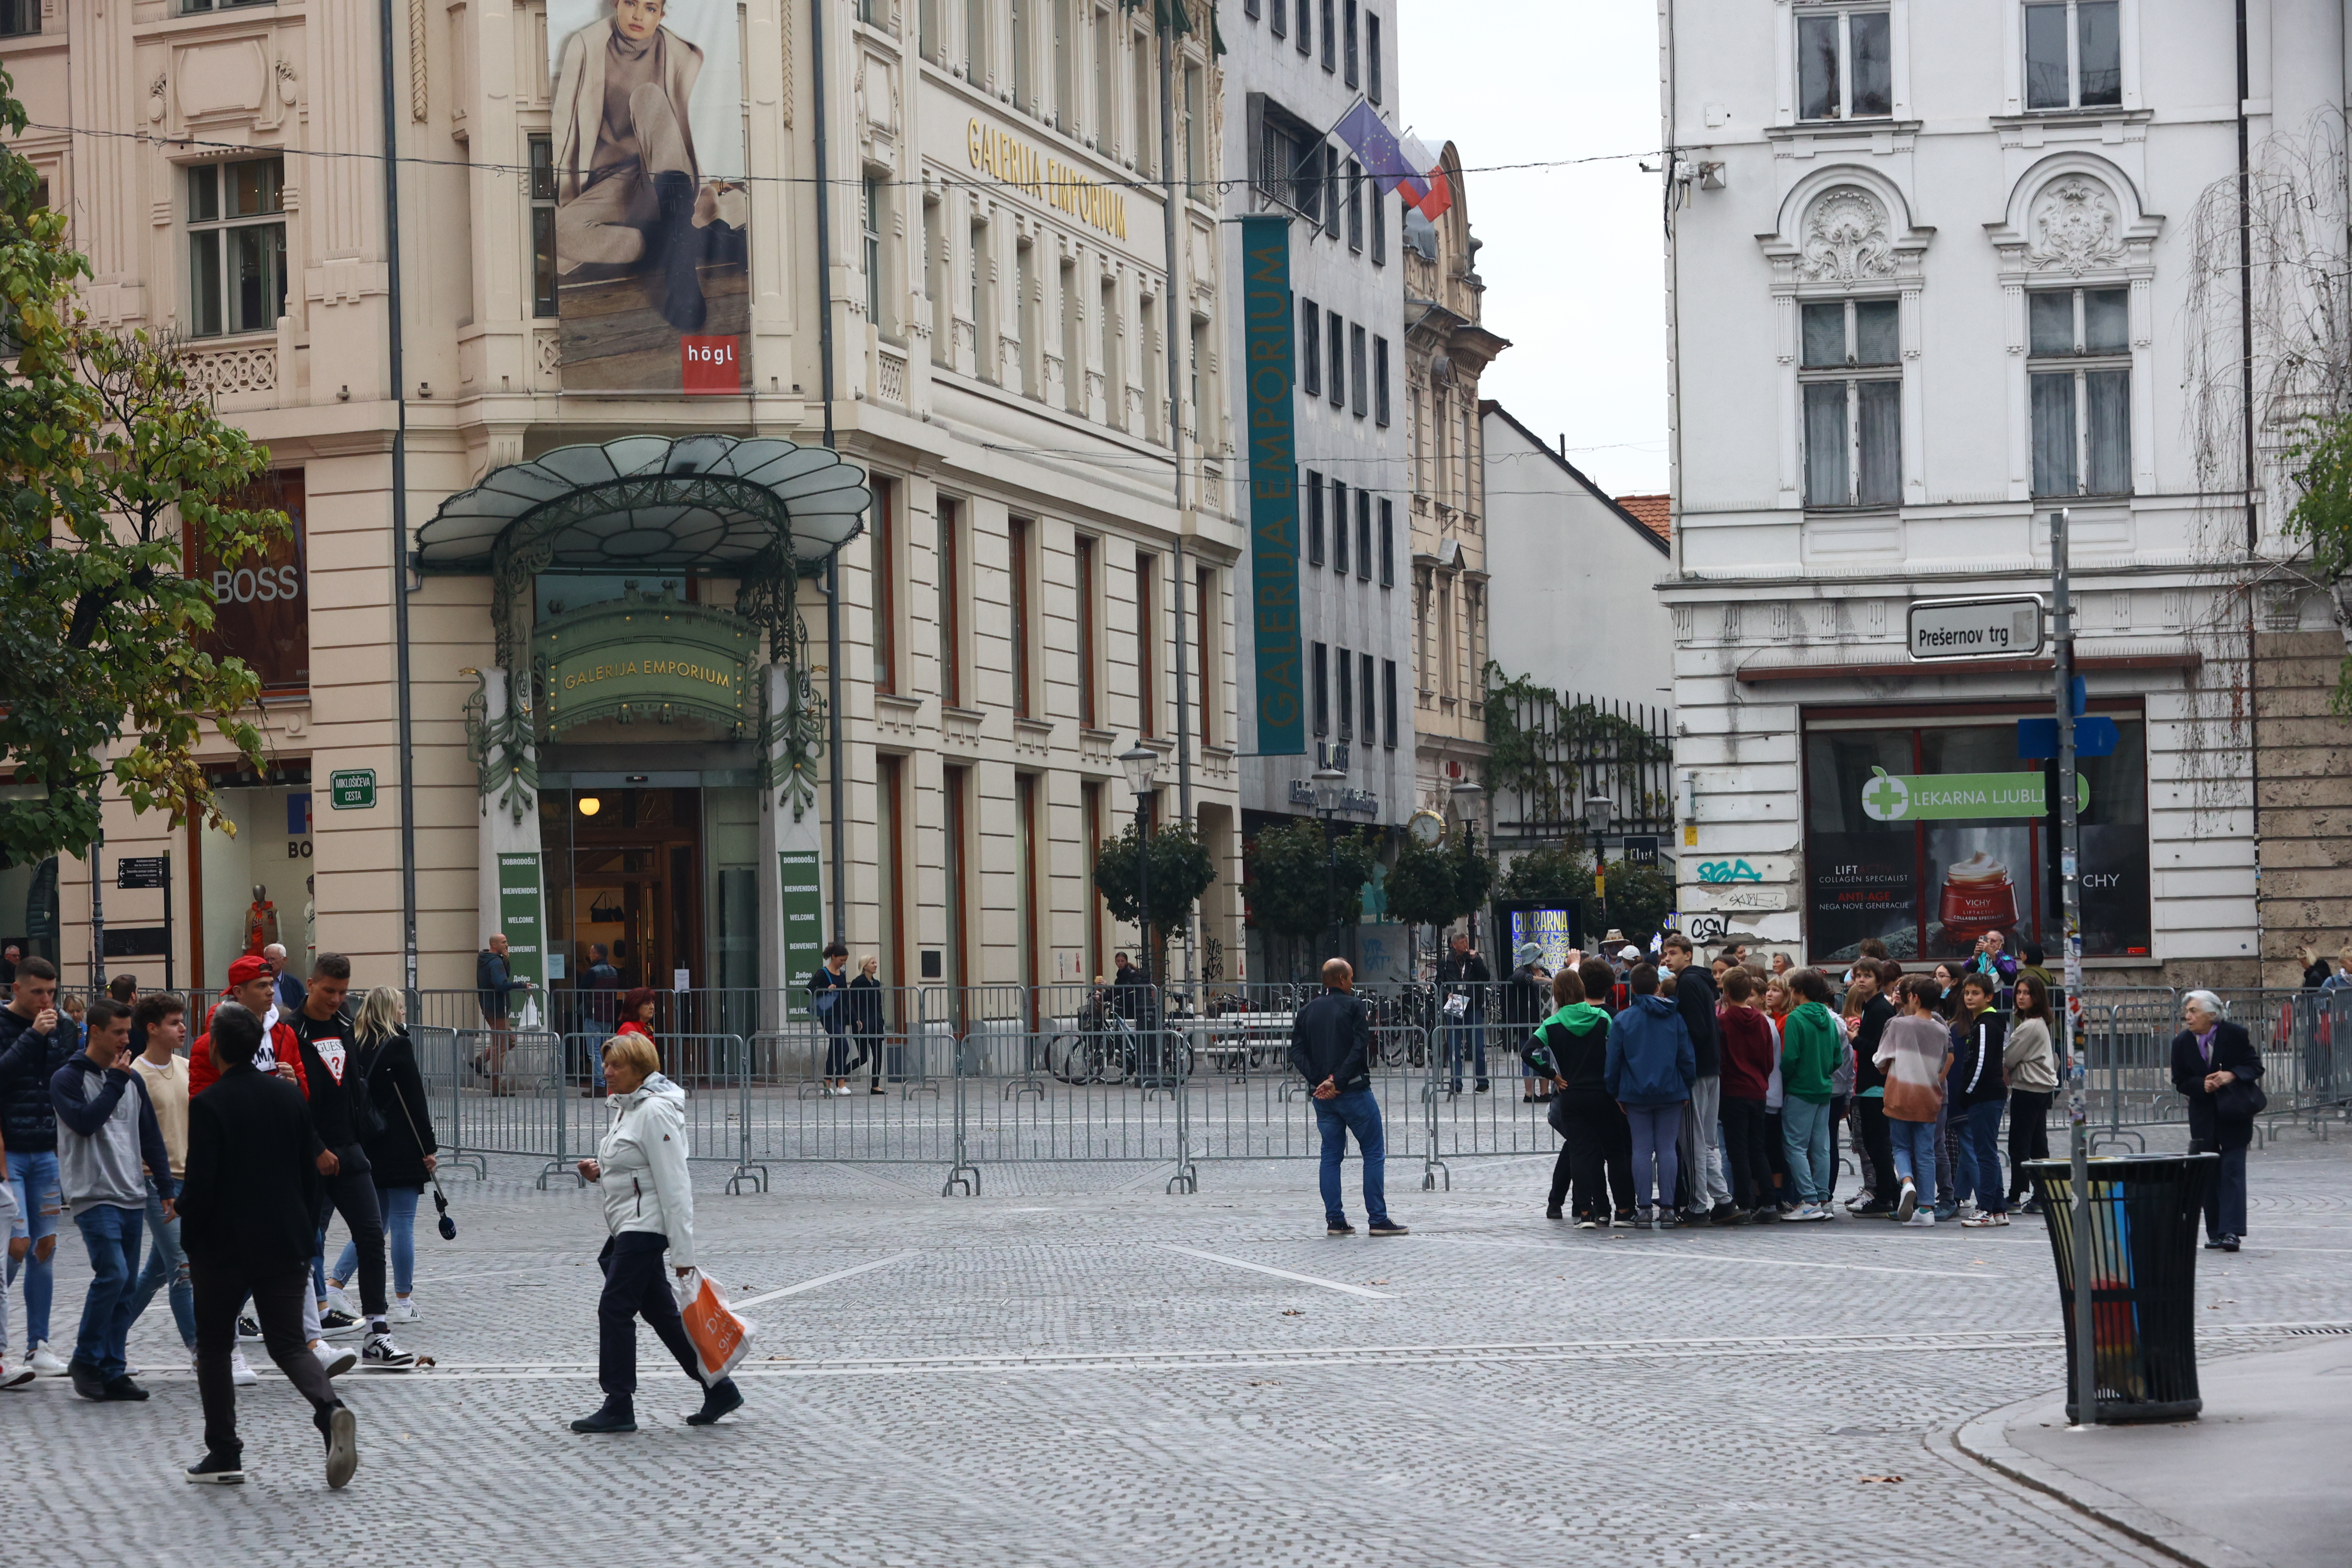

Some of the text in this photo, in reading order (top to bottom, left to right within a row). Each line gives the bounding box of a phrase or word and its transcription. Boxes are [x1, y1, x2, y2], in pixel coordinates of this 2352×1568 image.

[968, 117, 1127, 242] GALERIJA EMPORIUM
[1249, 245, 1298, 727] GALERIJA EMPORIUM
[213, 565, 298, 604] BOSS
[1920, 625, 2008, 646] Prešernov trg
[564, 660, 729, 689] GALERIJA EMPORIUM
[335, 775, 371, 788] MIKLOŠIČEVA
[345, 791, 361, 801] CESTA
[1914, 790, 1986, 806] LEKARNA
[502, 857, 536, 865] DOBRODOŠLI
[784, 855, 815, 864] DOBRODOŠLI
[2082, 873, 2120, 888] CHY
[1838, 891, 1890, 902] ANTI-AGE
[1513, 910, 1568, 933] CUKRARNA
[316, 1041, 344, 1053] GUESS
